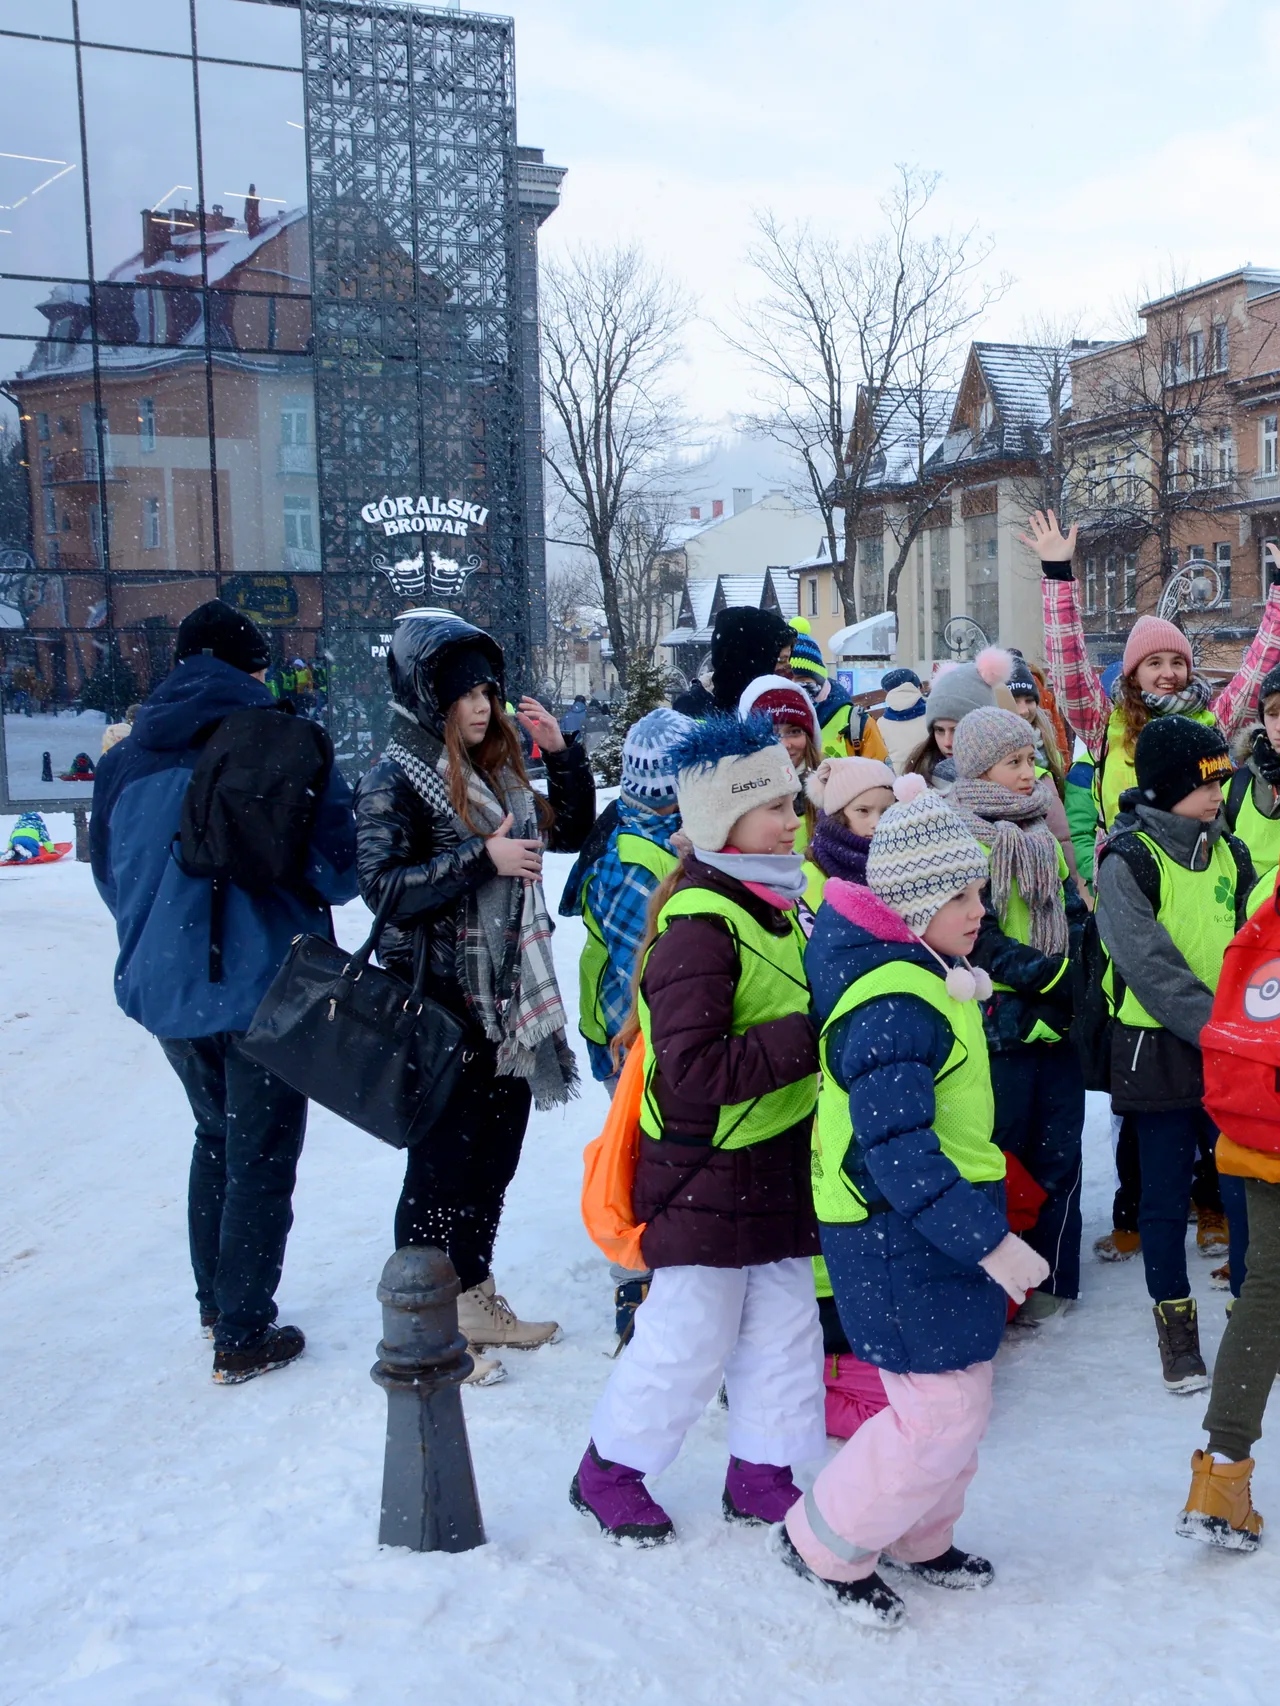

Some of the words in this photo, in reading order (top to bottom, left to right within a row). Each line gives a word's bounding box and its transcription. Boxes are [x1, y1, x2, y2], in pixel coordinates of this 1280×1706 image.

[361, 495, 489, 526] GÓRALSKI
[383, 517, 468, 536] BROWAR
[731, 777, 771, 794] Eisbär
